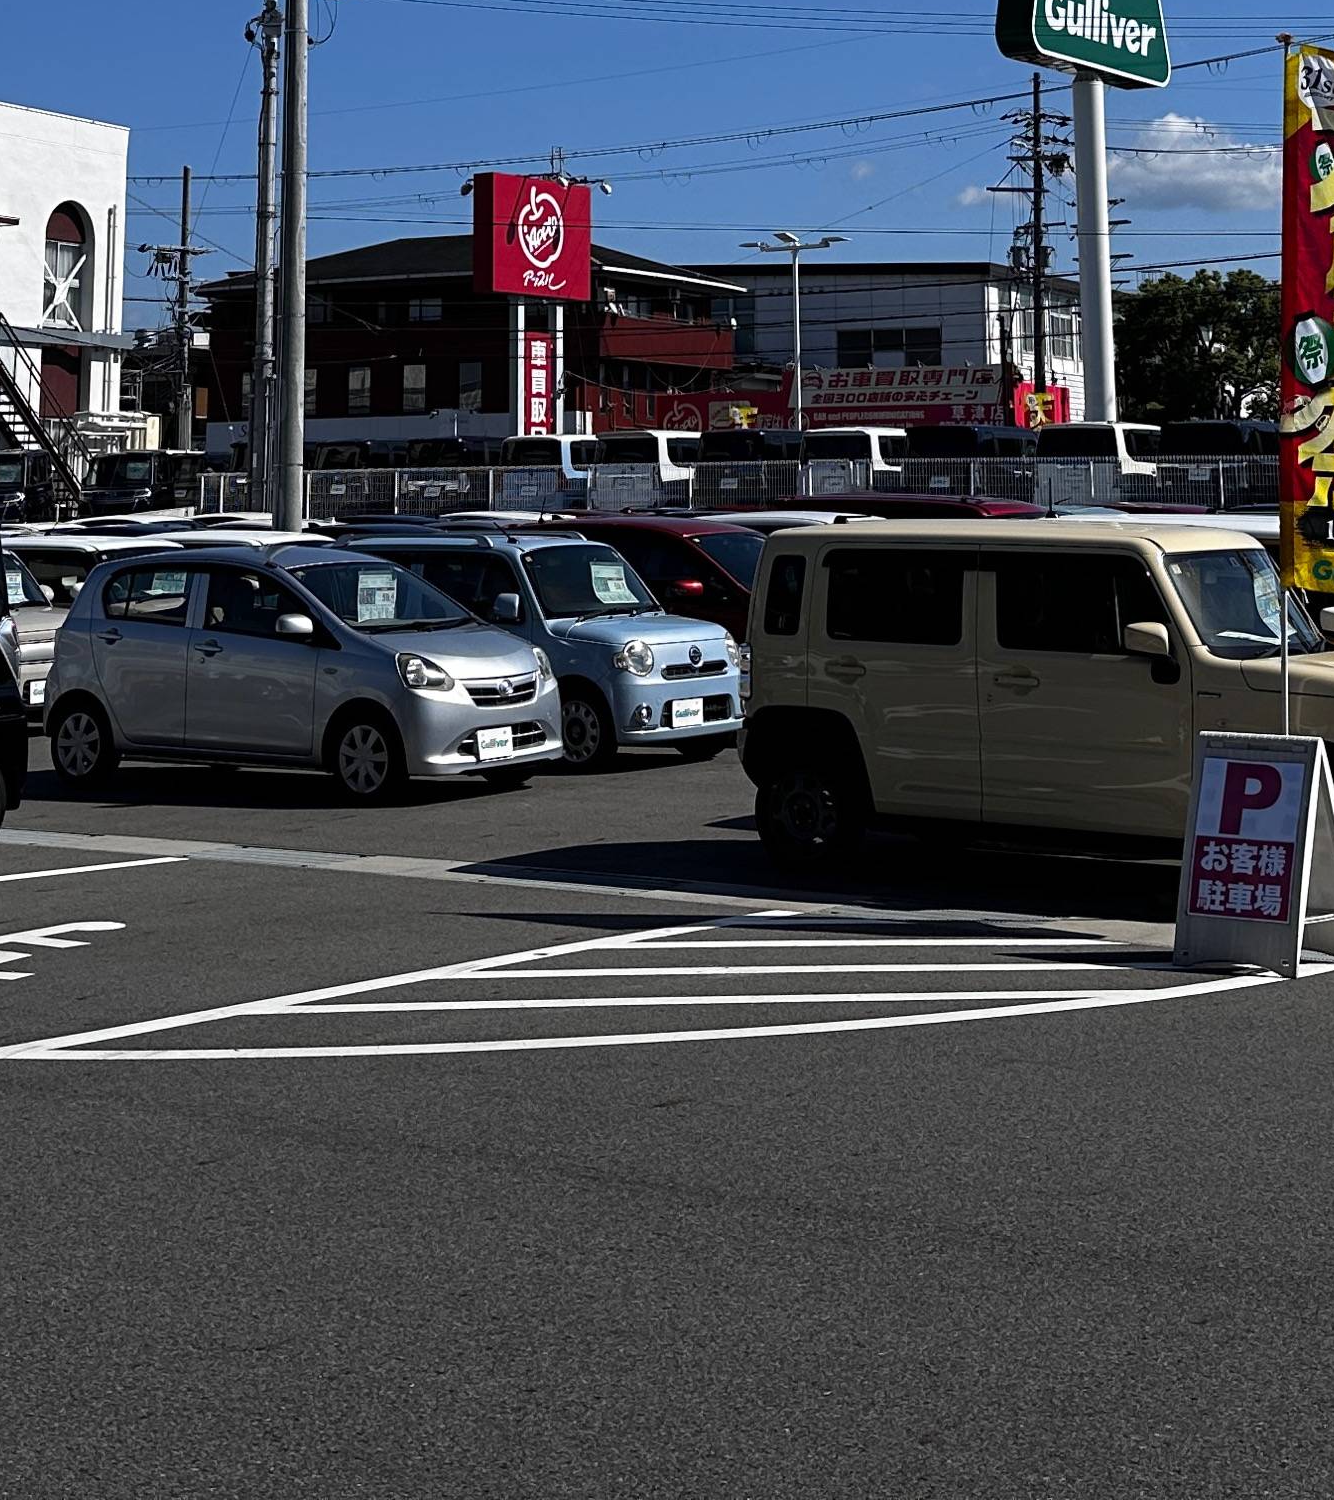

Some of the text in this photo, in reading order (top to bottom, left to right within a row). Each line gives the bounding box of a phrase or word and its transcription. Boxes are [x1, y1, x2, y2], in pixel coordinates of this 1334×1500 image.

[1298, 333, 1324, 370] 祭
[480, 737, 509, 749] Gulliver
[1219, 761, 1282, 835] P
[1200, 840, 1287, 877] お客様
[1196, 879, 1283, 917] 駐車場
